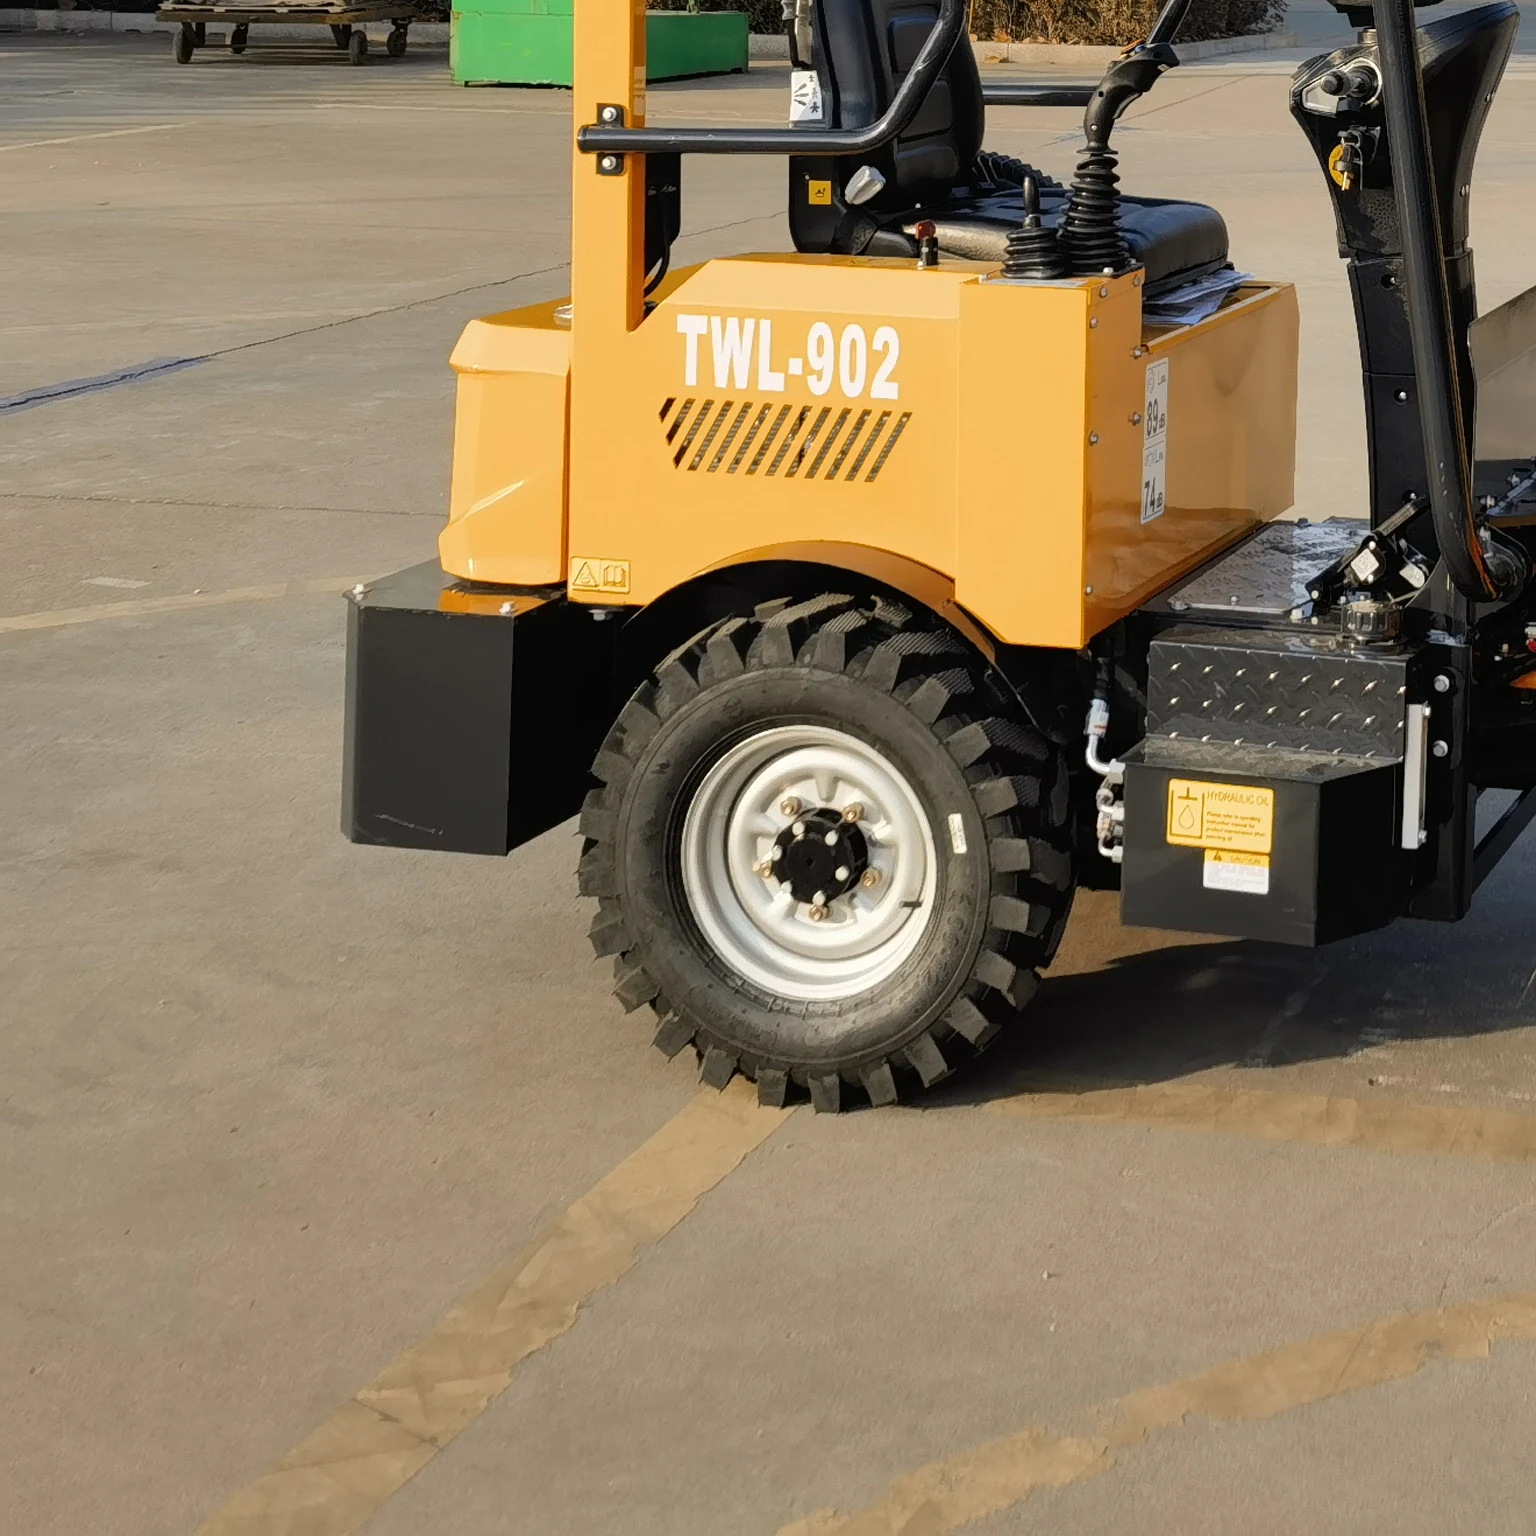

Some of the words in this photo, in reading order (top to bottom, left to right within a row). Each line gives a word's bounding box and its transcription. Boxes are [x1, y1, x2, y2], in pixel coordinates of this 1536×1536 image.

[676, 314, 899, 400] TWL-902
[1146, 398, 1159, 437] 89
[1143, 477, 1157, 516] 74
[1207, 790, 1255, 805] HYDRAULIC
